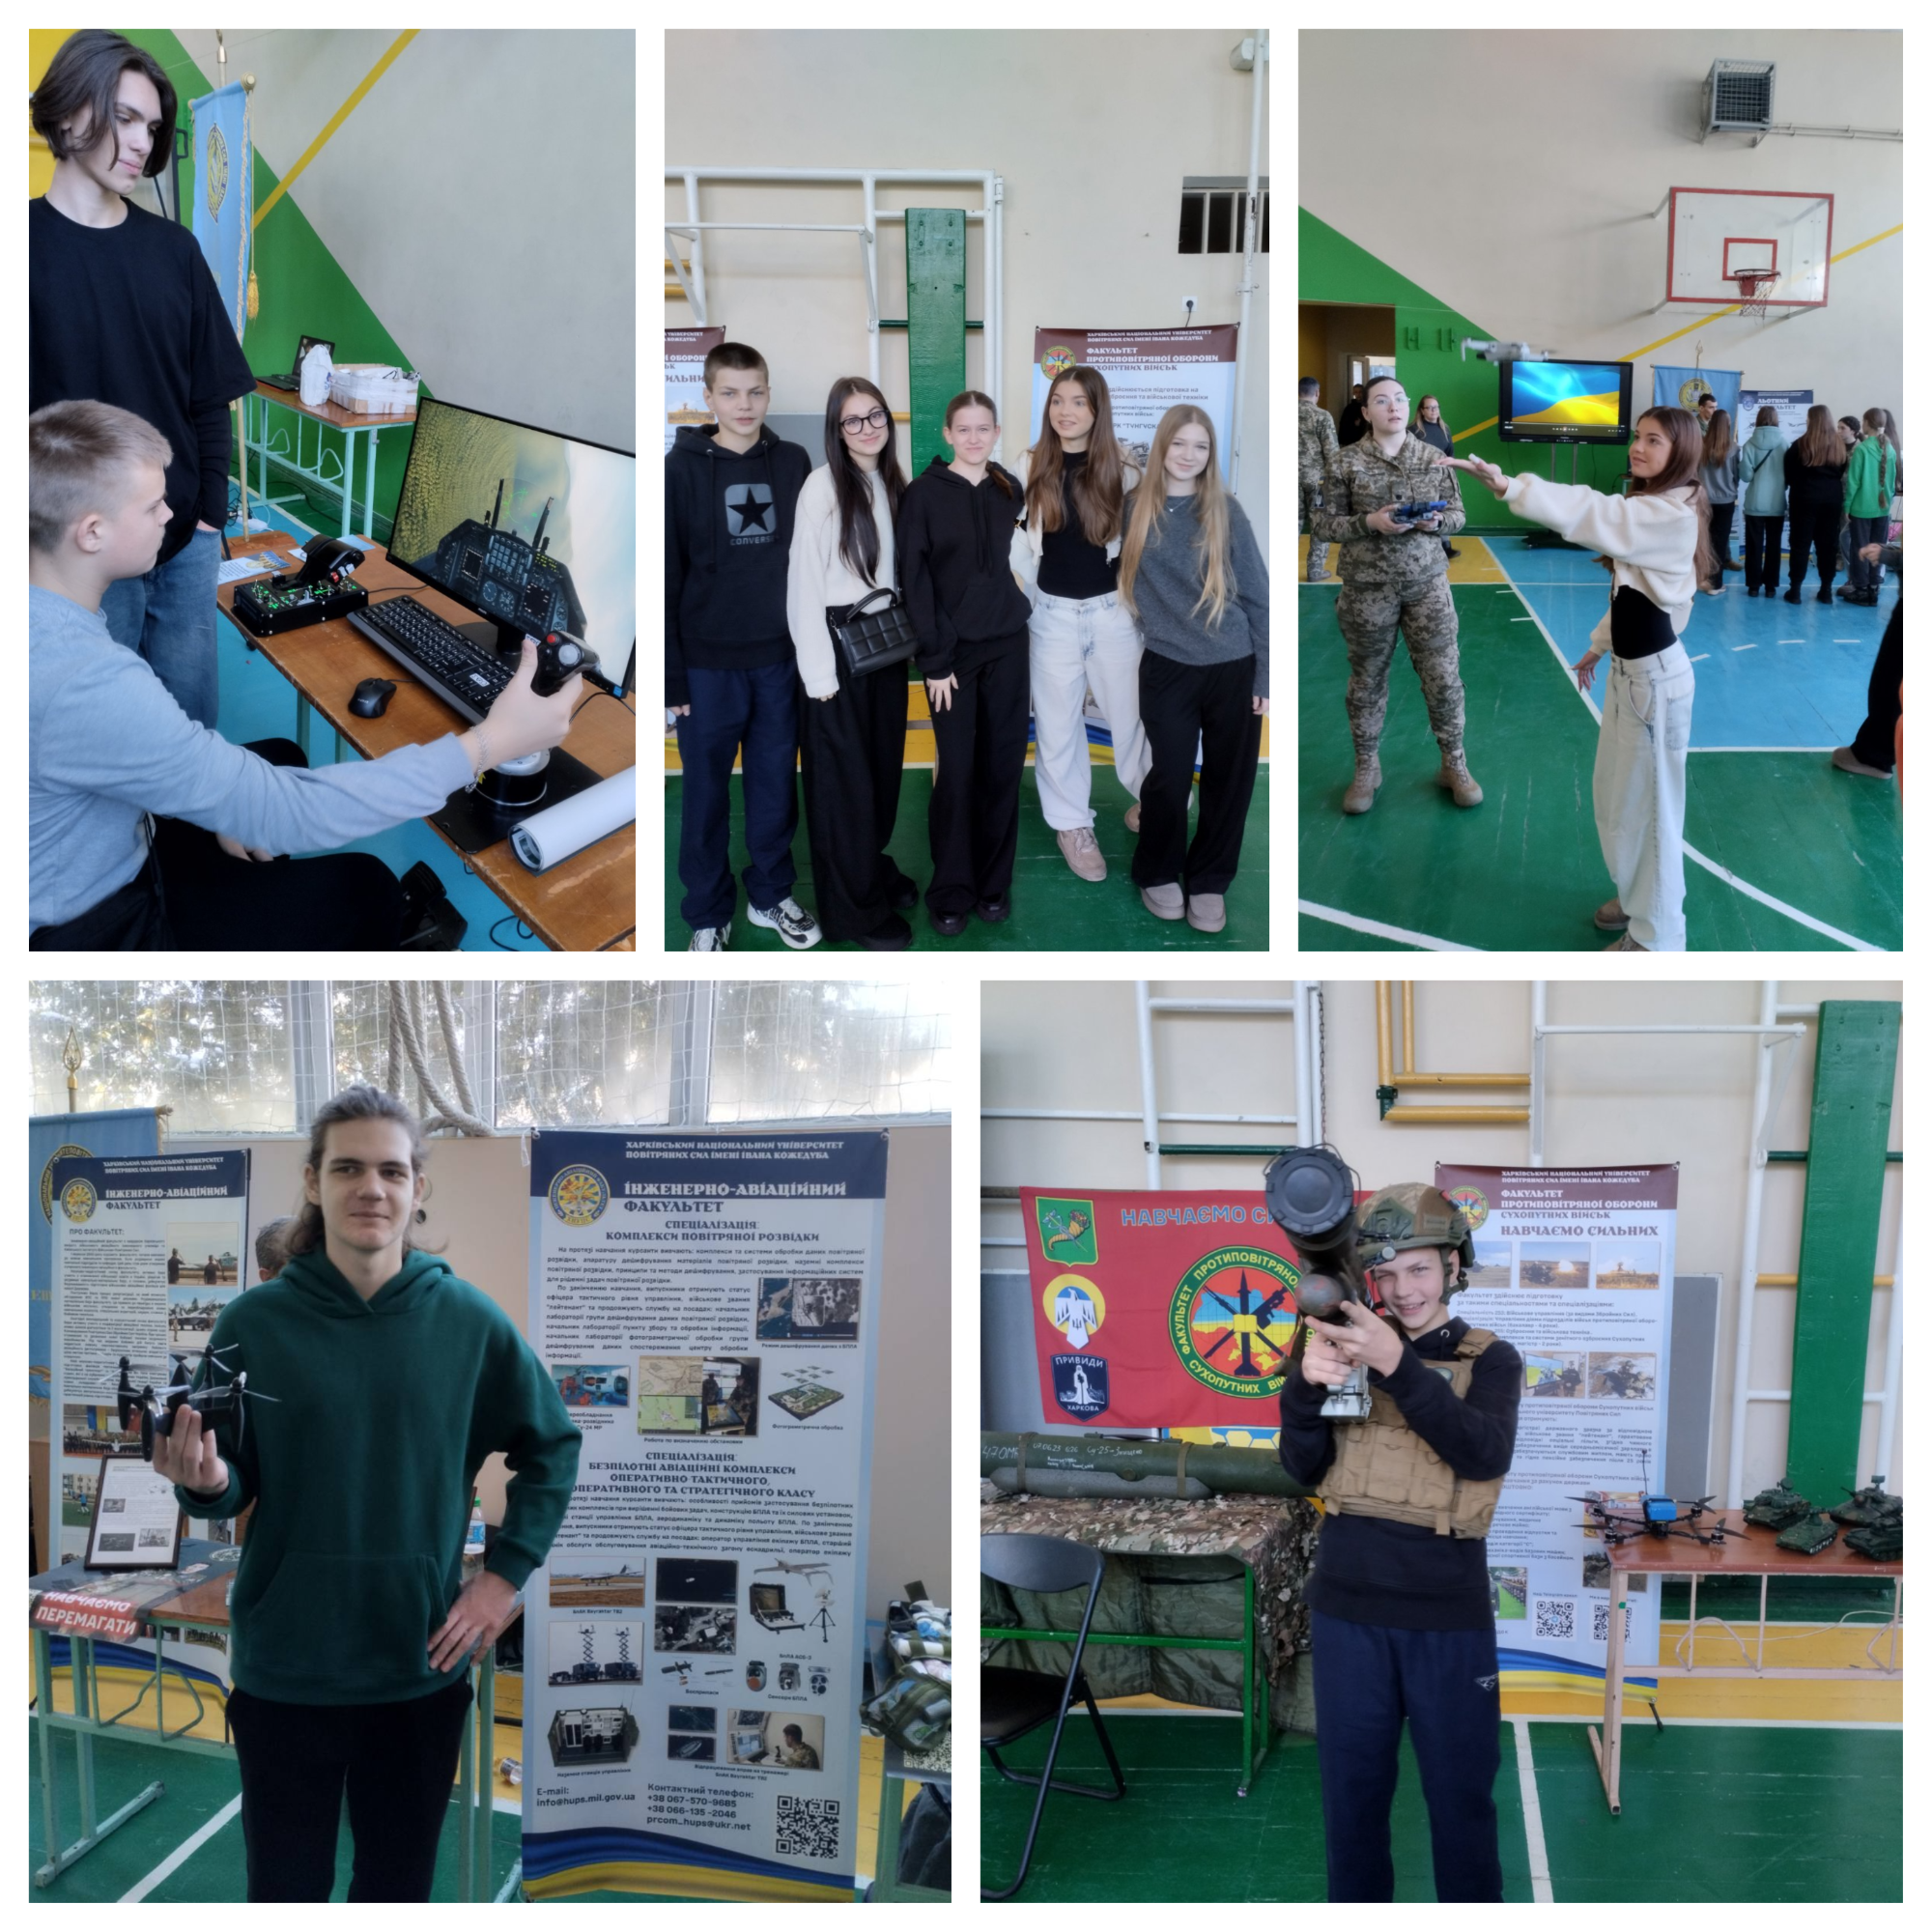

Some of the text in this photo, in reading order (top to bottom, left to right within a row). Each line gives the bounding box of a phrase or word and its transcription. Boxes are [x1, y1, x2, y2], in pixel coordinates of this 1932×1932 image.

[625, 1141, 845, 1149] ХАРКІВСЬКИЙ НАЦІОНАЛЬНИЙ УНІВЕРСИТЕТ
[625, 1151, 829, 1159] ПОВІТРЯНИХ СИЛ ІМЕНІ ІВАНА КОЖЕДУБА
[105, 1185, 228, 1199] ІНЖЕНЕРНО-АВІАЦІЙНИЙ
[623, 1181, 846, 1196] ІНЖЕНЕРНО-АВІАЦІЙНИЙ
[1500, 1190, 1563, 1198] ФАКУЛЬТЕТ
[105, 1200, 161, 1210] ФАКУЛЬТЕТ
[623, 1201, 724, 1213] ФАКУЛЬТЕТ
[1500, 1199, 1658, 1209] ПРОТИПОВІТРЯНОЇ ОБОРОНИ
[1121, 1206, 1246, 1226] НАВЧАЄМО
[1500, 1211, 1611, 1219] СУХОПУТНИХ ВІЙСЬК
[1500, 1225, 1659, 1236] НАВЧАЄМО СИЛЬНИХ
[605, 1232, 819, 1242] КОМПЛЕКСИ ПОВІТРЯНОЇ РОЗВІДКИ
[558, 1246, 566, 1254] На
[568, 1246, 593, 1254] протязі
[594, 1246, 626, 1254] навчання
[627, 1246, 658, 1254] курсанти
[659, 1247, 694, 1255] вивчають:
[695, 1247, 732, 1255] комплекси
[1174, 1284, 1193, 1355] ФАКУЛЬТЕТ
[1055, 1356, 1104, 1368] ПРИВИДИ
[1189, 1359, 1260, 1393] СУХОПУТНИХ
[1067, 1404, 1099, 1412] ХАРКОВА
[589, 1462, 796, 1475] БЕЗПІЛОТНІ АВІАЦІЙНІ КОМПЛЕКСИ
[664, 1486, 677, 1496] ТА
[680, 1486, 774, 1497] СТРАТЕГІЧНОГО
[776, 1488, 815, 1498] КЛАСУ
[43, 1591, 131, 1612] НАВЧАЄМО
[36, 1606, 137, 1635] ПЕРЕМАГАТИ
[648, 1783, 755, 1799] Контактний телефон:
[536, 1793, 636, 1807] info@hups.mil.gov.ua
[647, 1795, 737, 1808] +38 067-570-9685
[647, 1805, 664, 1815] +38
[646, 1816, 751, 1831] prcom_hups@ukr.net
